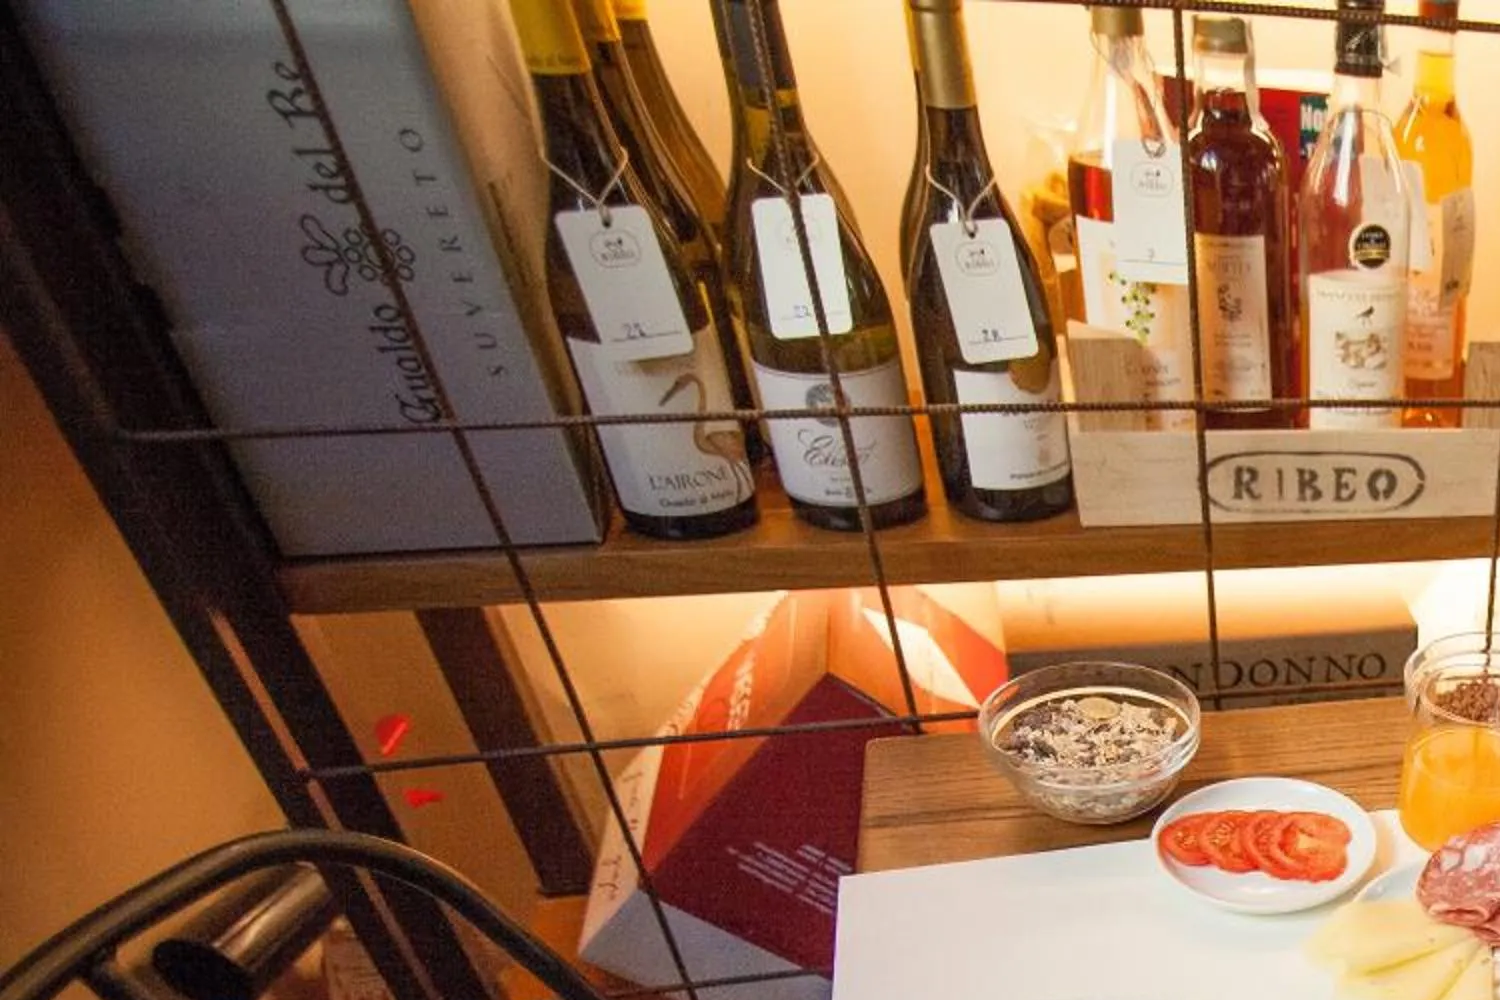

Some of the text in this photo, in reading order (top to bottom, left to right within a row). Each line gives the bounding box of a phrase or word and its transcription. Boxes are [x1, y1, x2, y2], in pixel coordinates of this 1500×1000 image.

[266, 62, 443, 424] Gualdo del Re
[399, 128, 505, 376] SUVERETO
[1232, 464, 1398, 502] RIBEO
